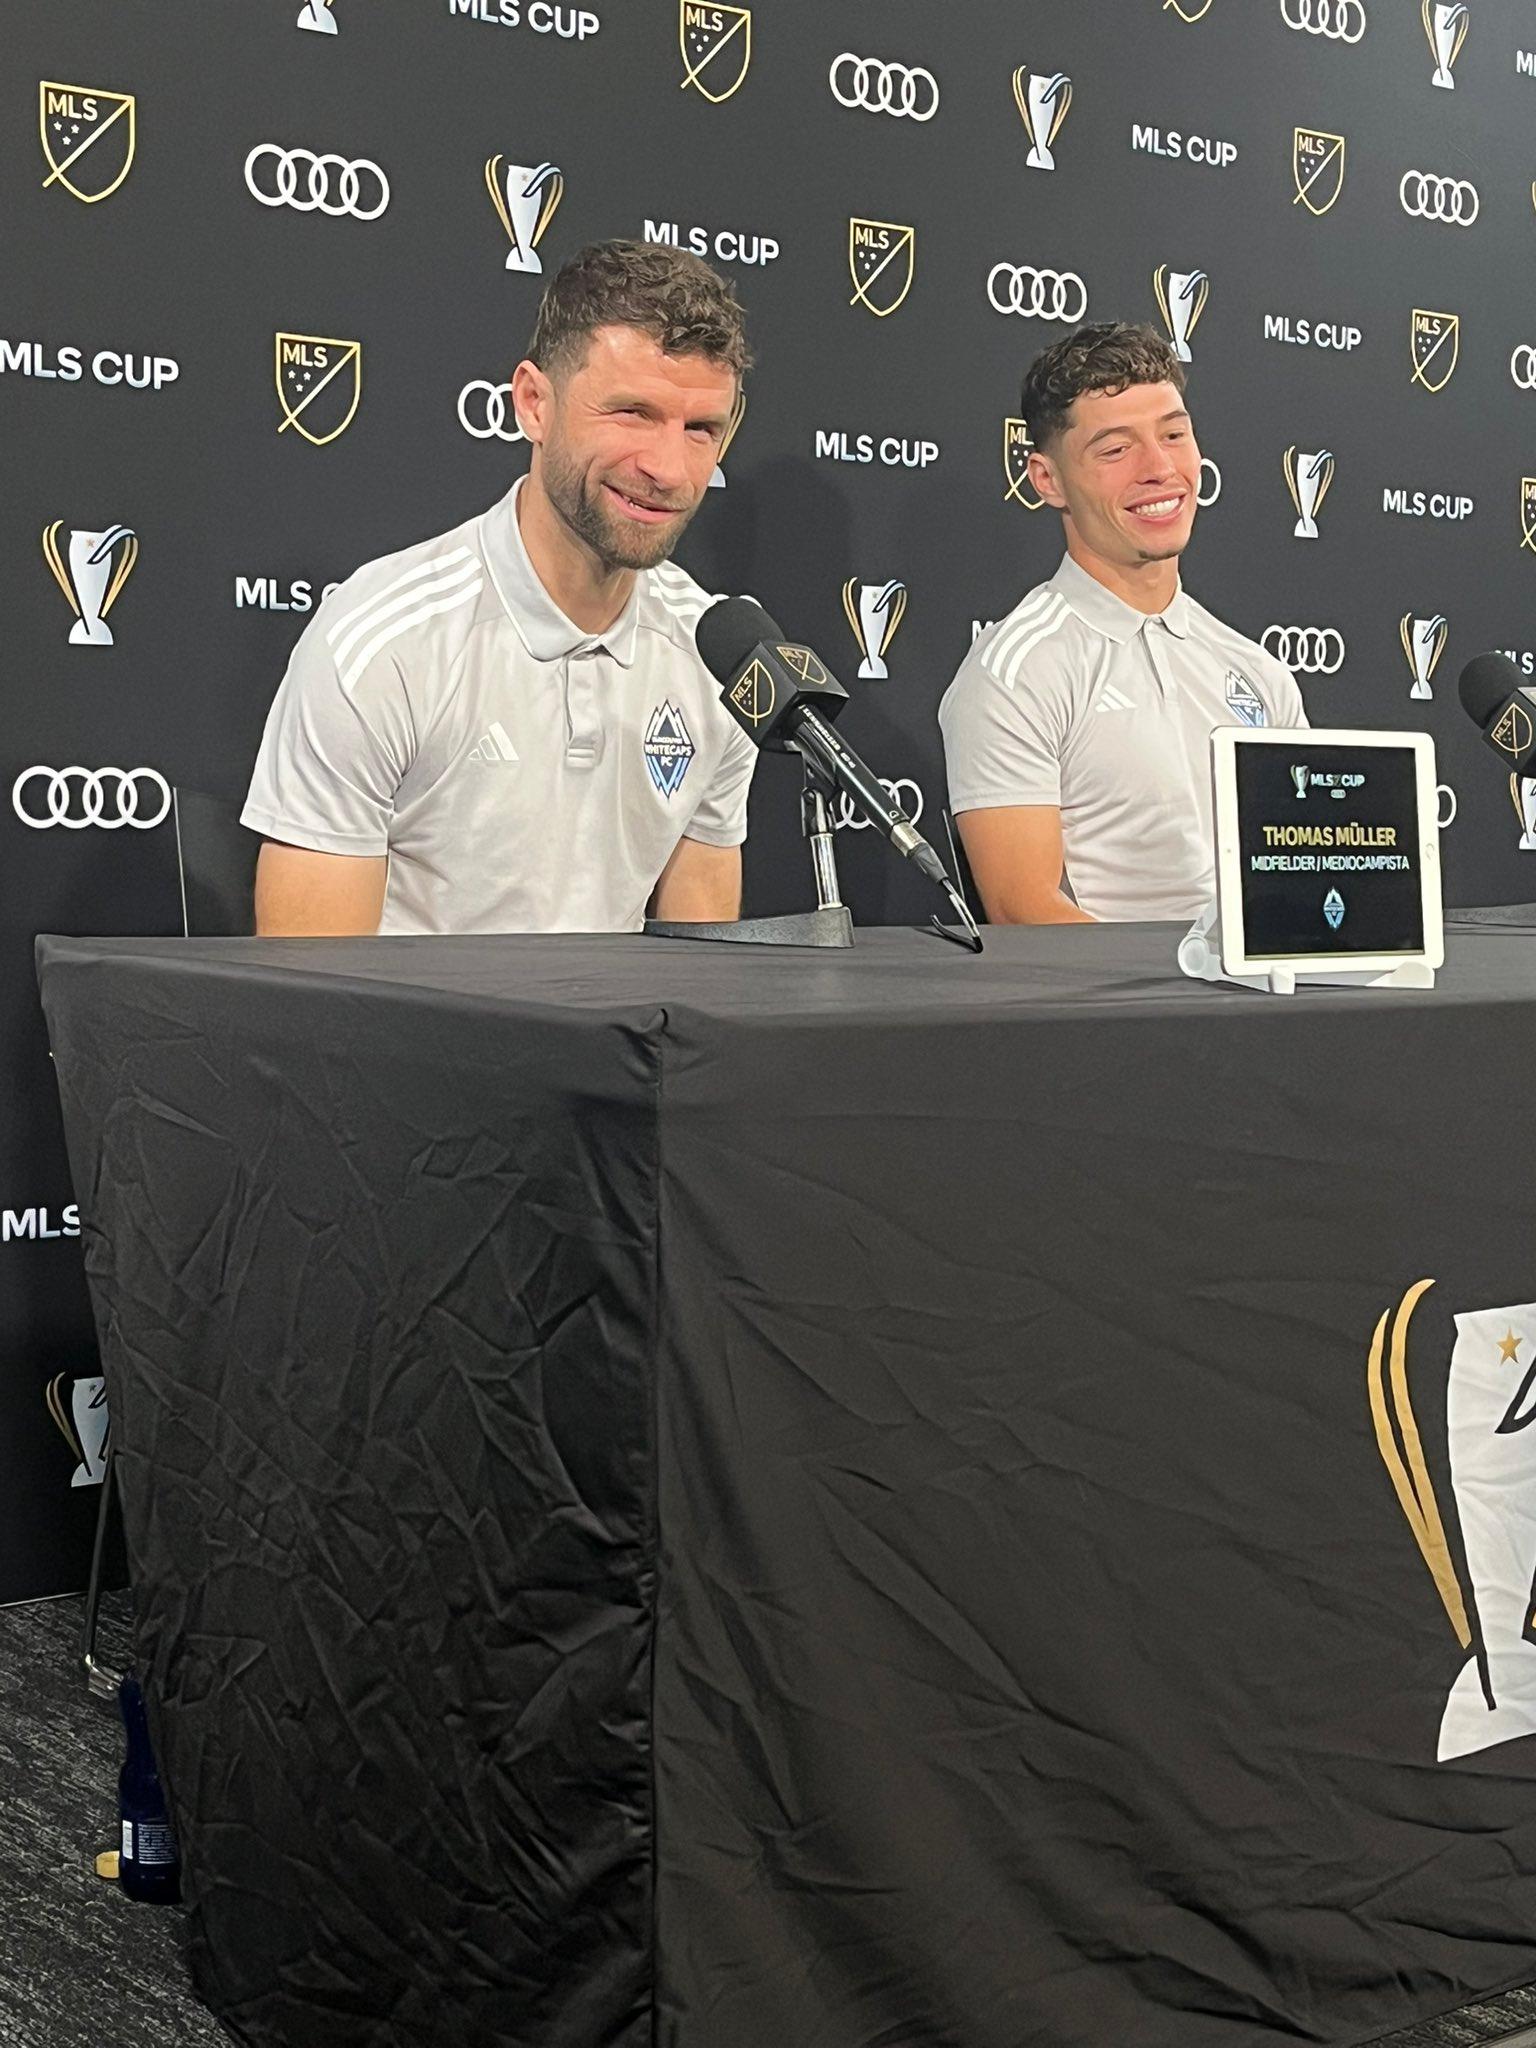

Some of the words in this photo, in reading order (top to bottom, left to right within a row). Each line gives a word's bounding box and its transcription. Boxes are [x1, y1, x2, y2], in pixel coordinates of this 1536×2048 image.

[527, 1, 600, 41] CUP
[686, 5, 724, 32] MLS
[48, 92, 98, 121] MLS
[1132, 124, 1182, 158] MLS
[1186, 136, 1238, 167] CUP
[1298, 134, 1326, 156] MLS
[644, 219, 708, 257] MLS
[714, 231, 780, 266] CUP
[855, 226, 890, 250] MLS
[1264, 314, 1310, 345] MLS
[1314, 322, 1362, 351] CUP
[1415, 316, 1441, 336] MLS
[0, 339, 83, 381] MLS
[91, 350, 179, 390] CUP
[283, 342, 329, 368] MLS
[815, 430, 874, 463] MLS
[879, 437, 939, 468] CUP
[1010, 426, 1034, 446] ML
[1383, 488, 1426, 516] MLS
[1429, 493, 1474, 520] CUP
[235, 576, 313, 612] MLS
[734, 677, 752, 701] MLS
[1310, 773, 1333, 787] MLS
[1341, 774, 1365, 788] CUP
[1262, 825, 1334, 847] THOMAS
[1336, 821, 1397, 847] MÜLLER
[1251, 855, 1316, 871] MIDFIELDER
[1322, 855, 1410, 871] MEDIOCAMPISTA
[2, 1204, 81, 1242] MLS
